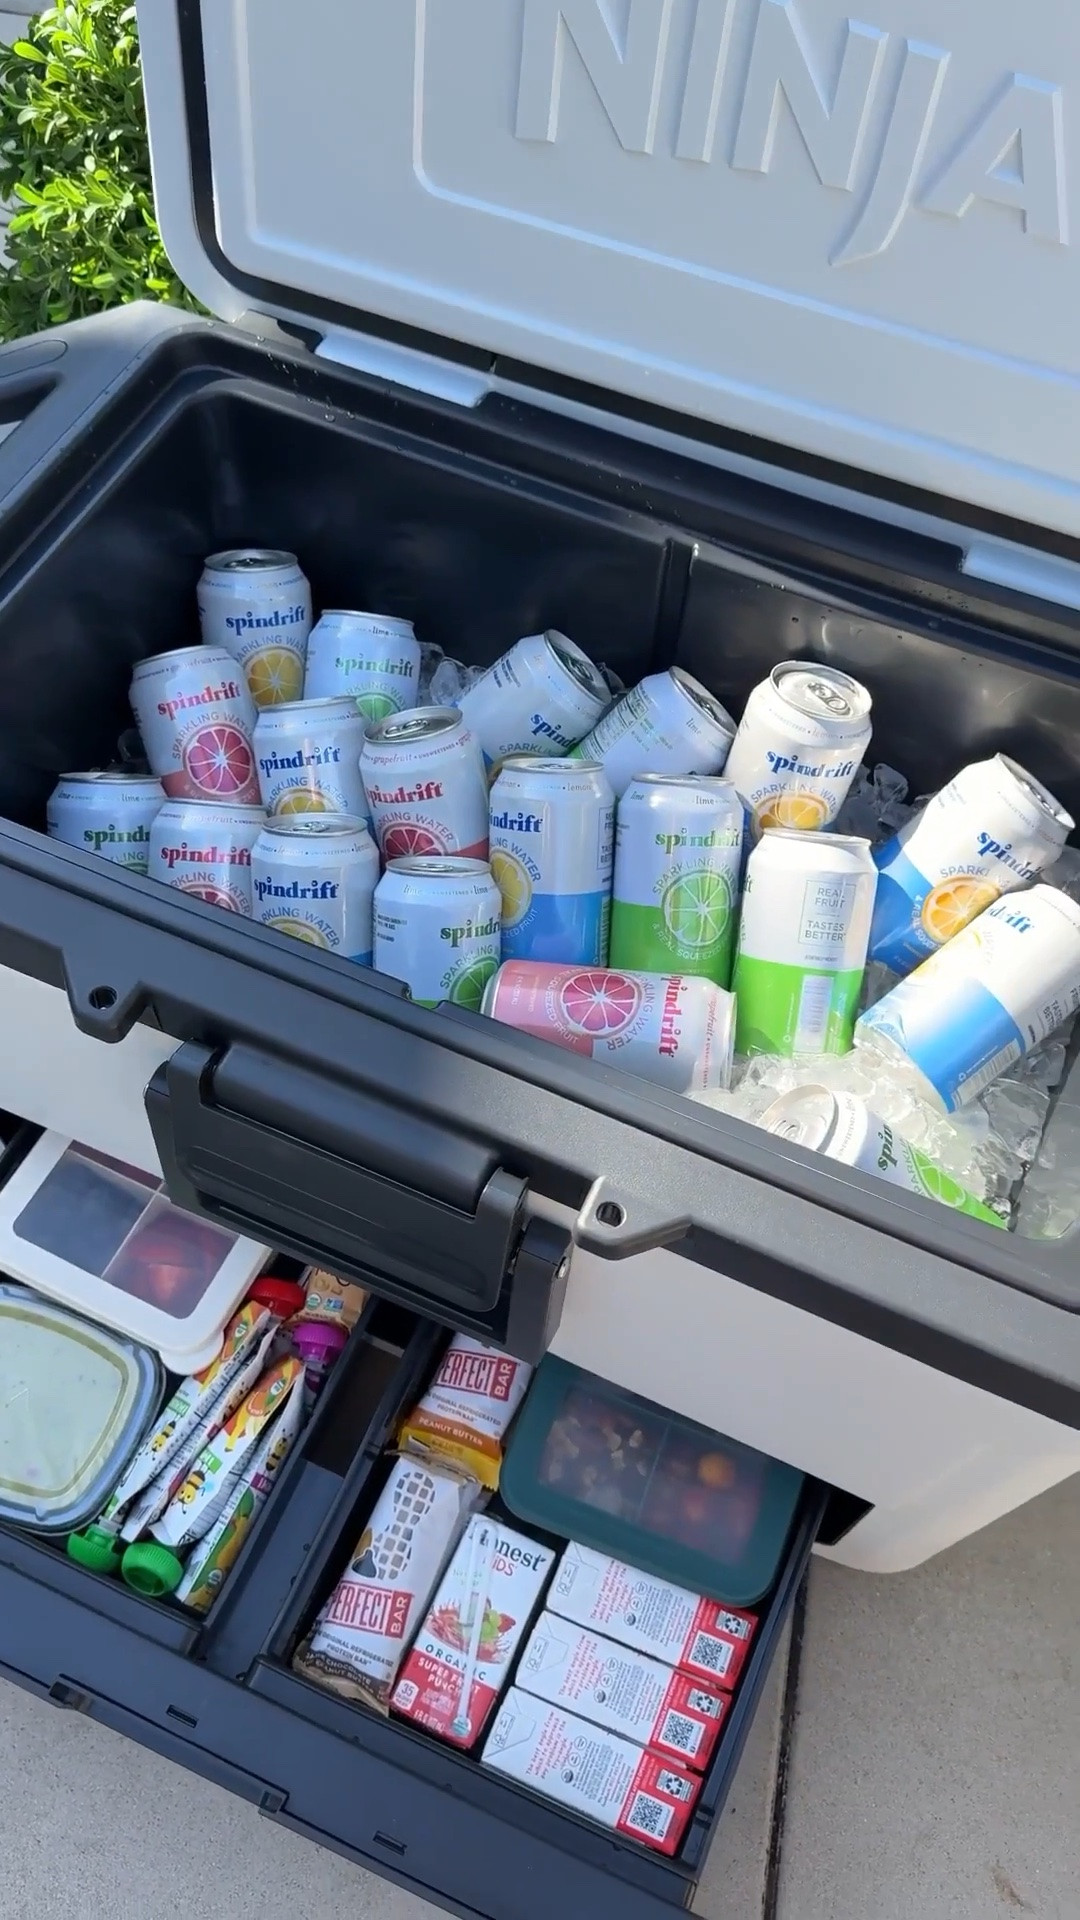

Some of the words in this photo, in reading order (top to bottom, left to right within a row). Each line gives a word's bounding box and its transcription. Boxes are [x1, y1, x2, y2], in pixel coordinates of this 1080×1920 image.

[515, 0, 1070, 267] NINJA
[225, 605, 306, 636] spindrift
[335, 652, 414, 678] spindrift
[157, 682, 241, 721] spindrift
[172, 711, 219, 760] SPARKLING
[530, 713, 577, 750] spind
[259, 746, 341, 778] spindrift
[766, 751, 854, 777] spindrift
[314, 778, 349, 808] WATER
[695, 795, 715, 805] lime
[416, 813, 454, 843] WATER
[655, 828, 740, 854] spindrift
[511, 842, 541, 882] WATER
[652, 857, 714, 894] SPARKLING
[254, 876, 339, 902] spindrift
[474, 885, 489, 895] lime
[815, 897, 845, 908] FRUIT
[818, 887, 844, 899] REAL
[305, 911, 340, 947] WATER
[520, 908, 539, 932] FRUIT
[807, 920, 844, 931] TASTES
[805, 930, 844, 941] BETTER
[659, 975, 688, 1058] spindrift
[553, 1021, 579, 1045] FRUIT
[606, 1017, 648, 1051] WATER
[438, 1352, 496, 1391] ERFECT
[494, 1362, 512, 1396] BAR
[419, 1417, 451, 1432] PEANUT
[452, 1426, 483, 1446] BUTTER
[391, 1596, 408, 1633] BAR
[327, 1643, 354, 1658] PROTEIN
[326, 1656, 371, 1685] CHOCOLATE
[401, 1683, 414, 1697] 35
[632, 1777, 641, 1792] AFTER
[637, 1754, 649, 1776] OPENING
